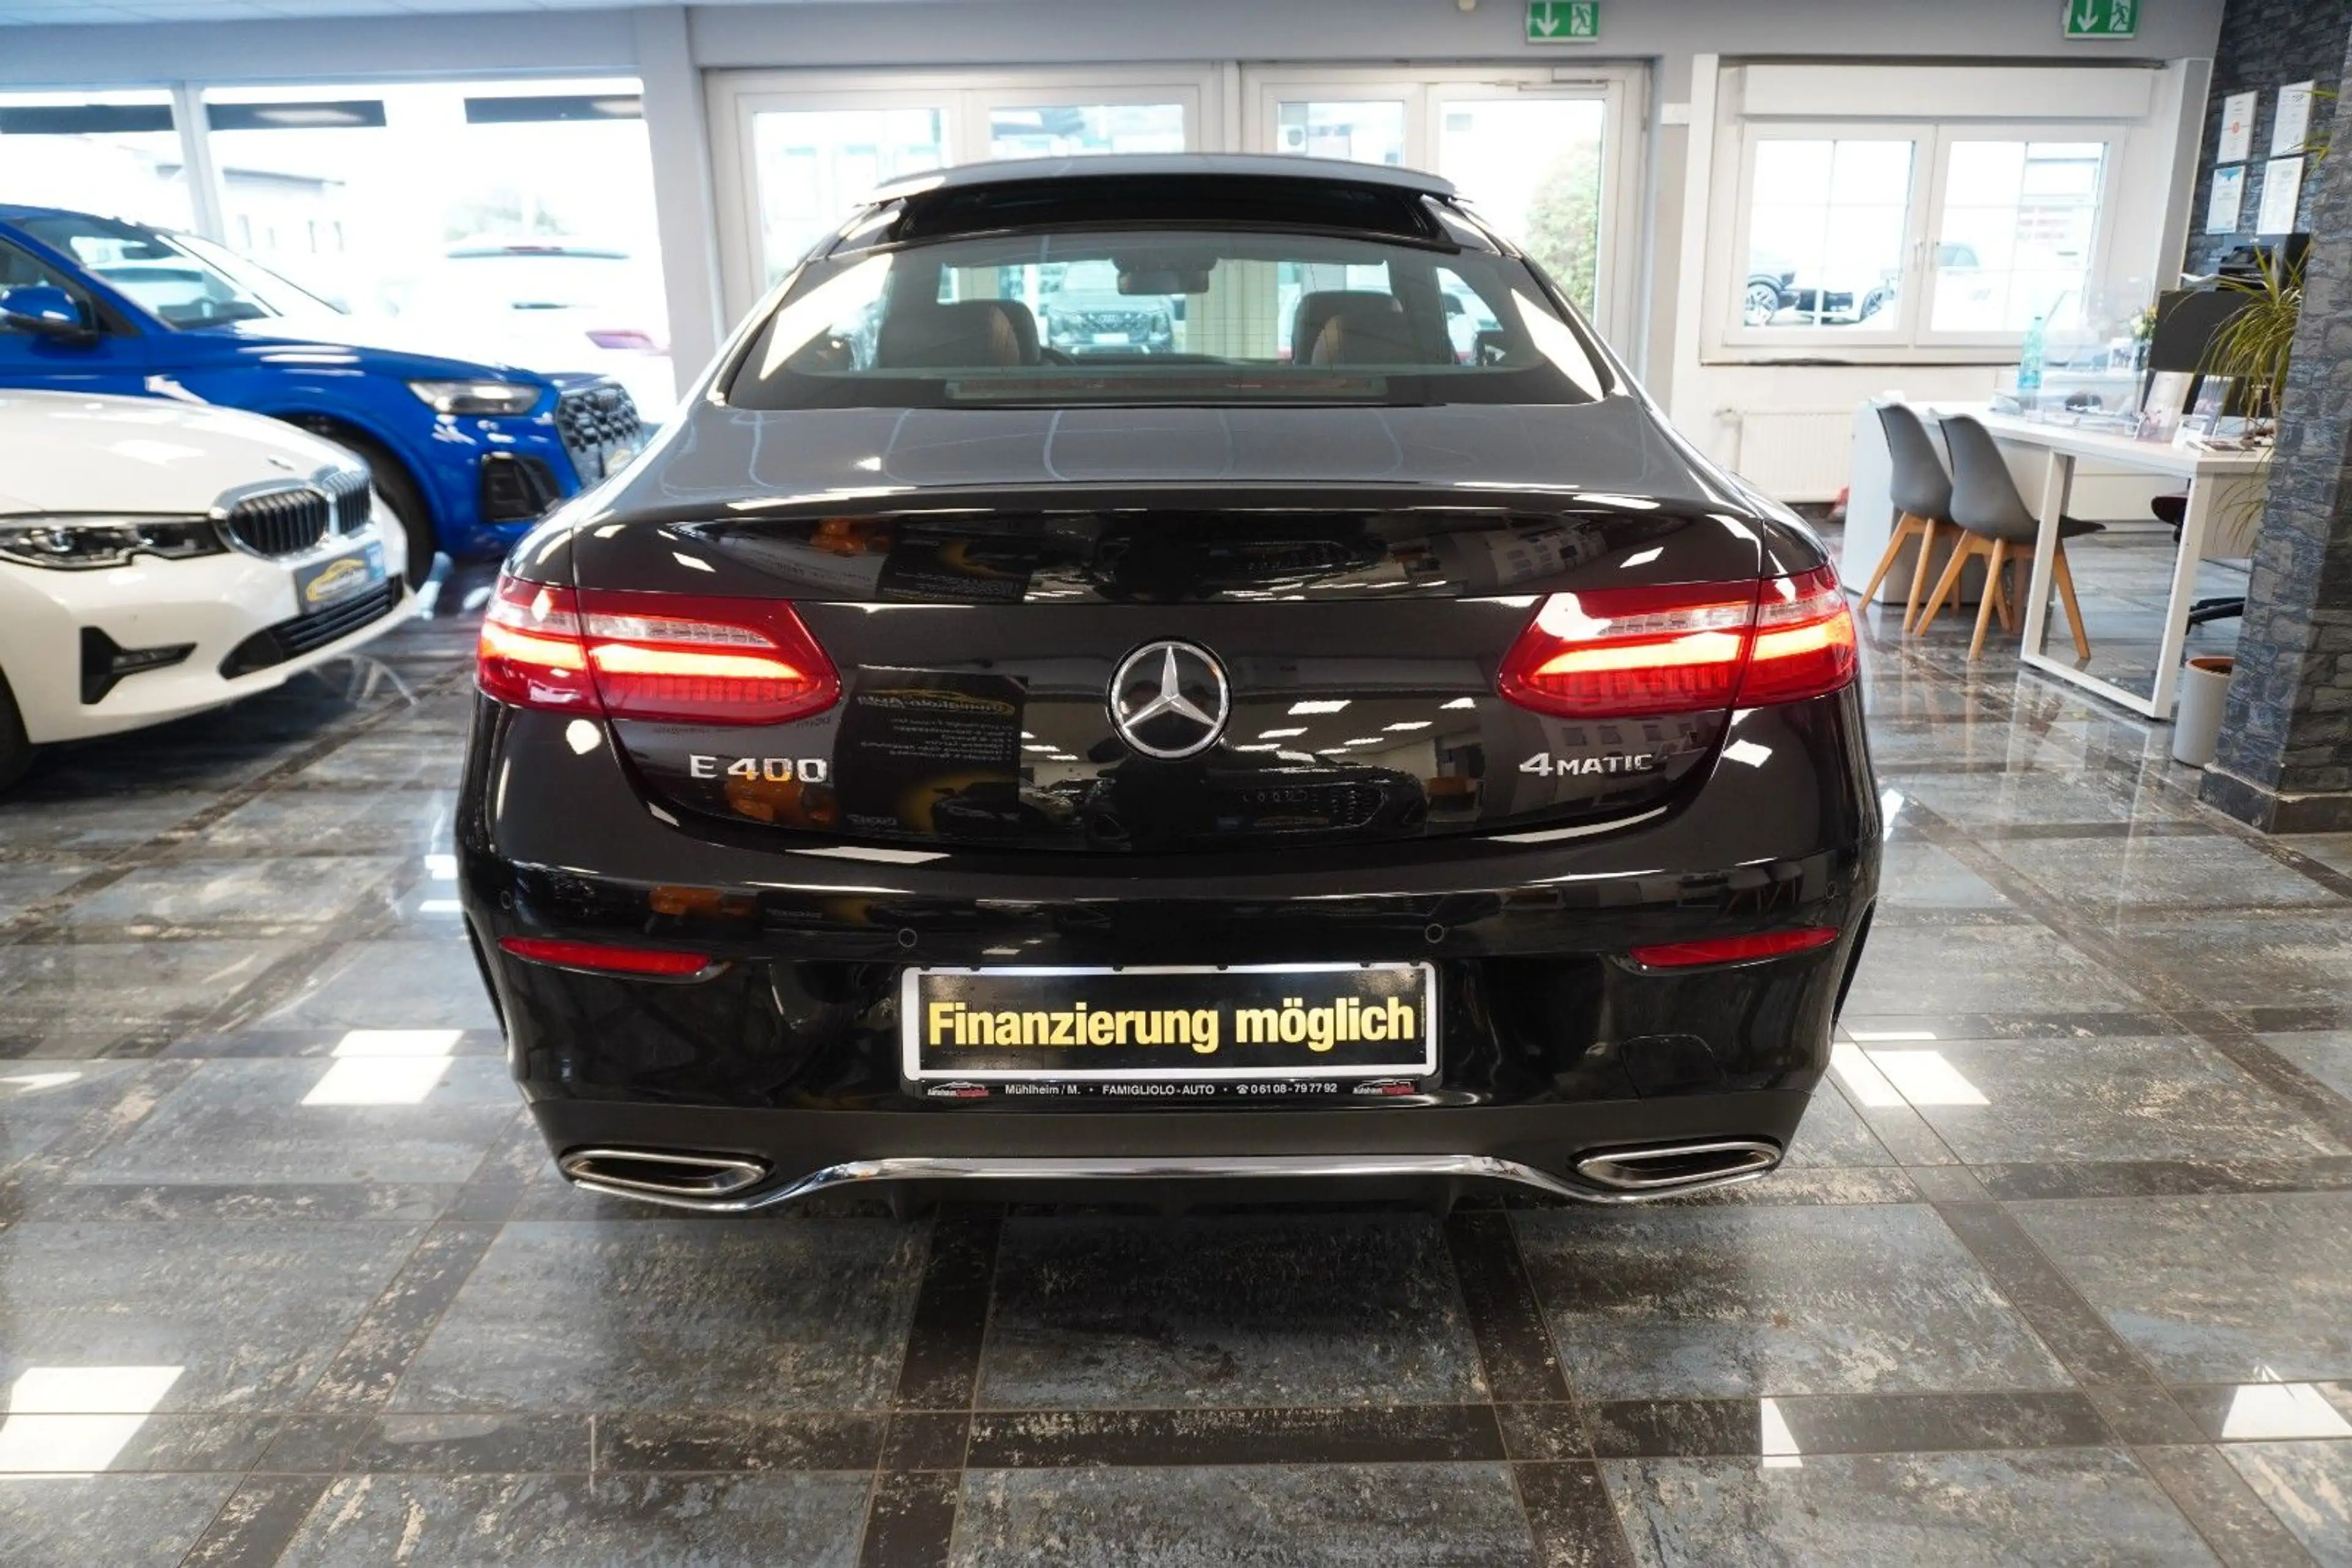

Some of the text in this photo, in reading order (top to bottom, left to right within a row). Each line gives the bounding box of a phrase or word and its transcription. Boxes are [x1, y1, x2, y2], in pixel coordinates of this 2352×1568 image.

[689, 754, 827, 783] E 400
[1518, 752, 1653, 777] 4MATIC
[928, 1001, 1219, 1054] Finanzierung
[1236, 996, 1414, 1052] möglich
[1005, 1084, 1059, 1095] Mühlheim
